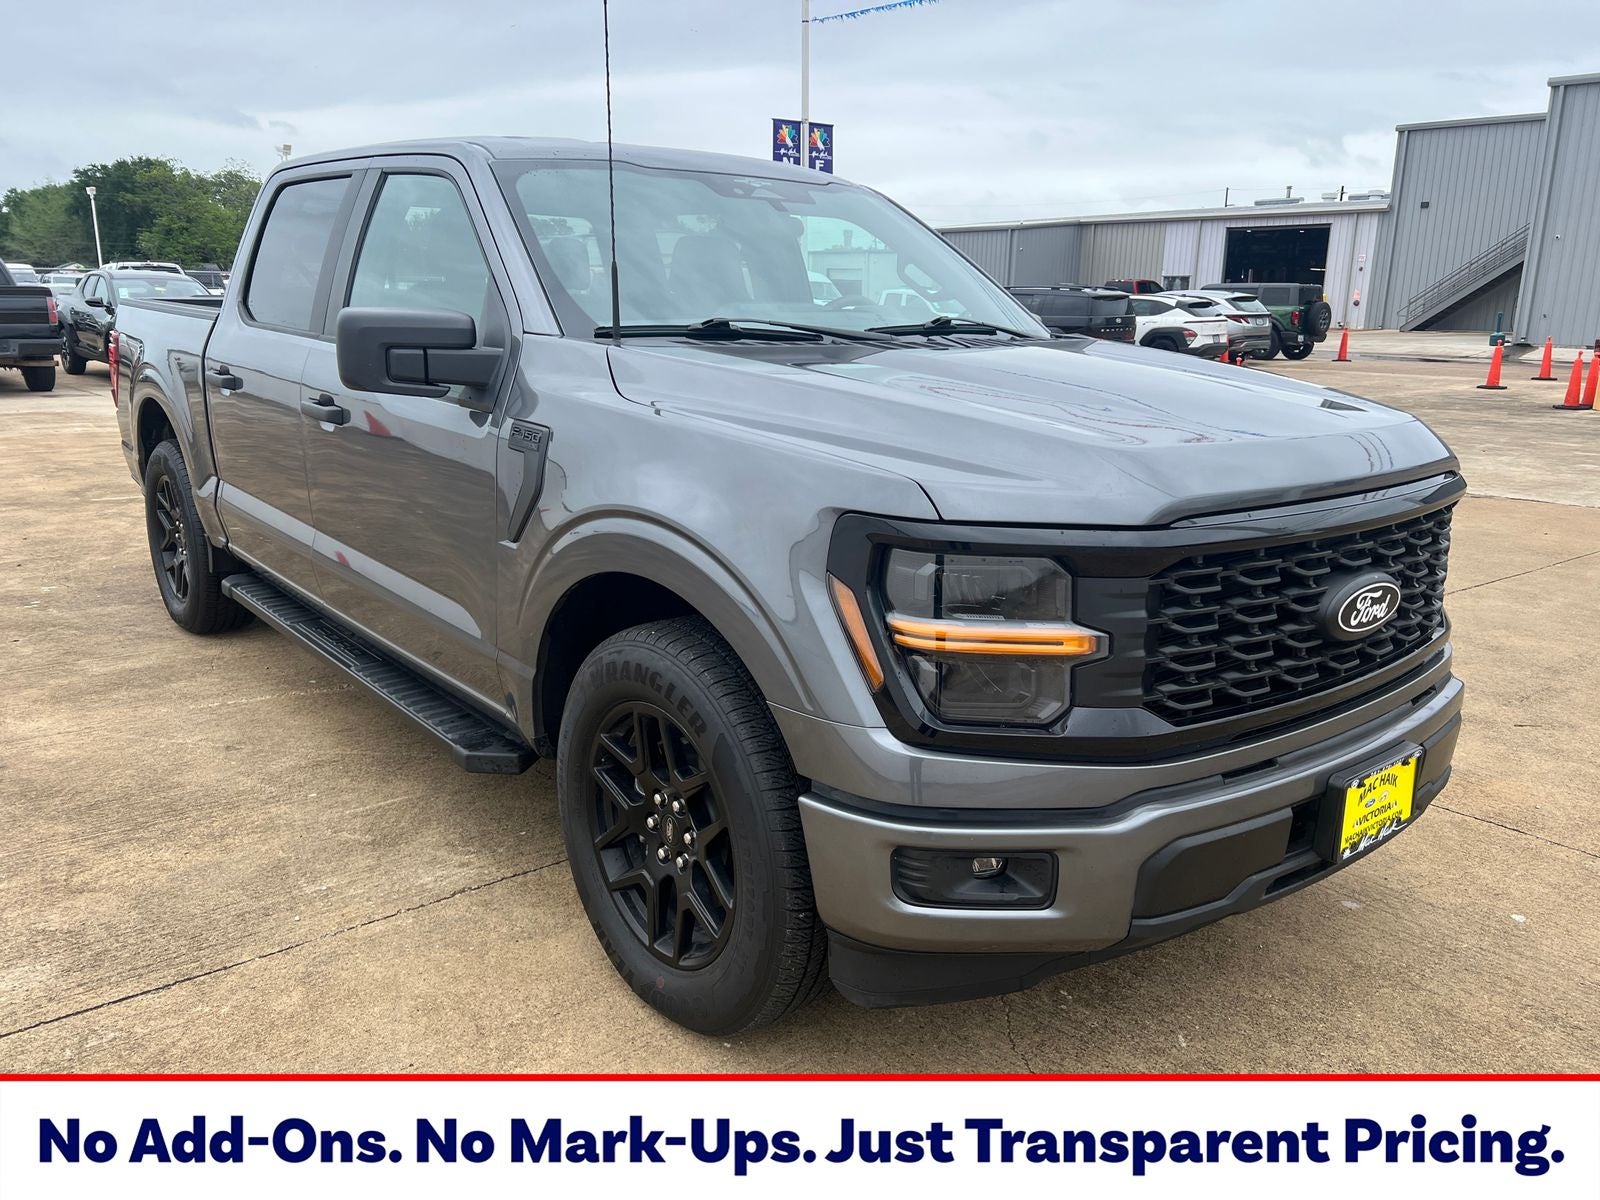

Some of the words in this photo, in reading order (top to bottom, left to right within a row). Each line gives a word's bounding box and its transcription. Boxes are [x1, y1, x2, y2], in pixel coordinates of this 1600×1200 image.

[1350, 590, 1391, 627] Ford
[590, 658, 707, 738] WRANGLER
[1358, 777, 1379, 806] MAC
[1379, 773, 1398, 787] HAIK
[1357, 801, 1394, 826] VICTORIA
